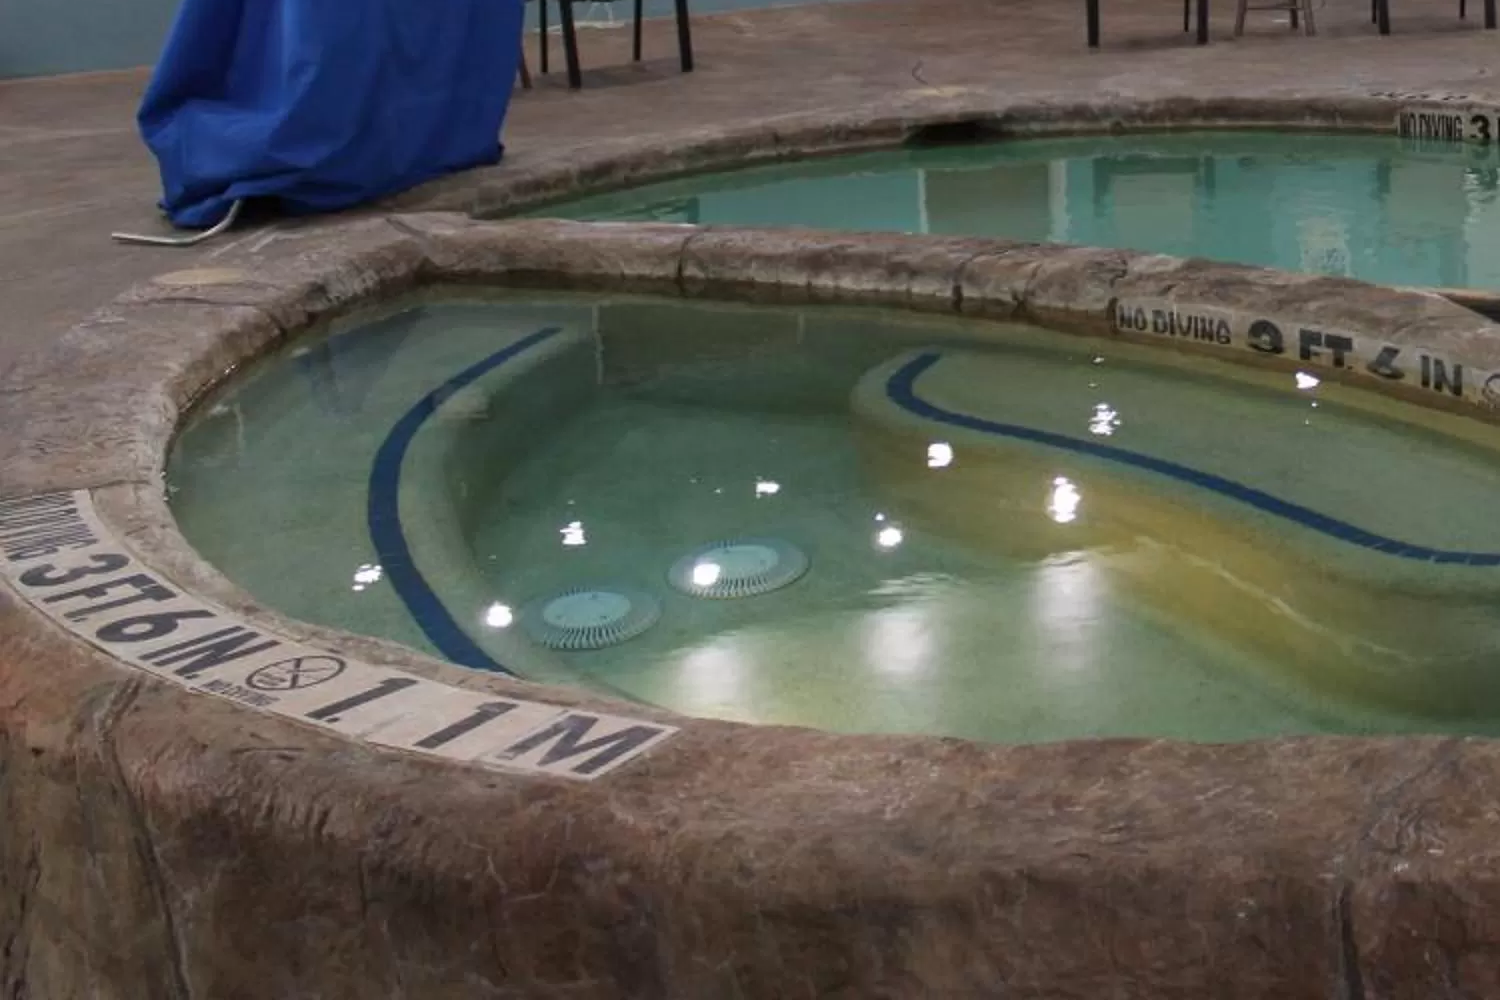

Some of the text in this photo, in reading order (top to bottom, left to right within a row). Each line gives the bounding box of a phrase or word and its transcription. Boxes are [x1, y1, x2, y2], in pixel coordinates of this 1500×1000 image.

[1470, 115, 1490, 146] 3
[1119, 304, 1148, 331] NO
[1152, 309, 1231, 344] DIVING
[19, 553, 130, 587] 3
[96, 609, 218, 643] 6
[498, 714, 664, 774] M
